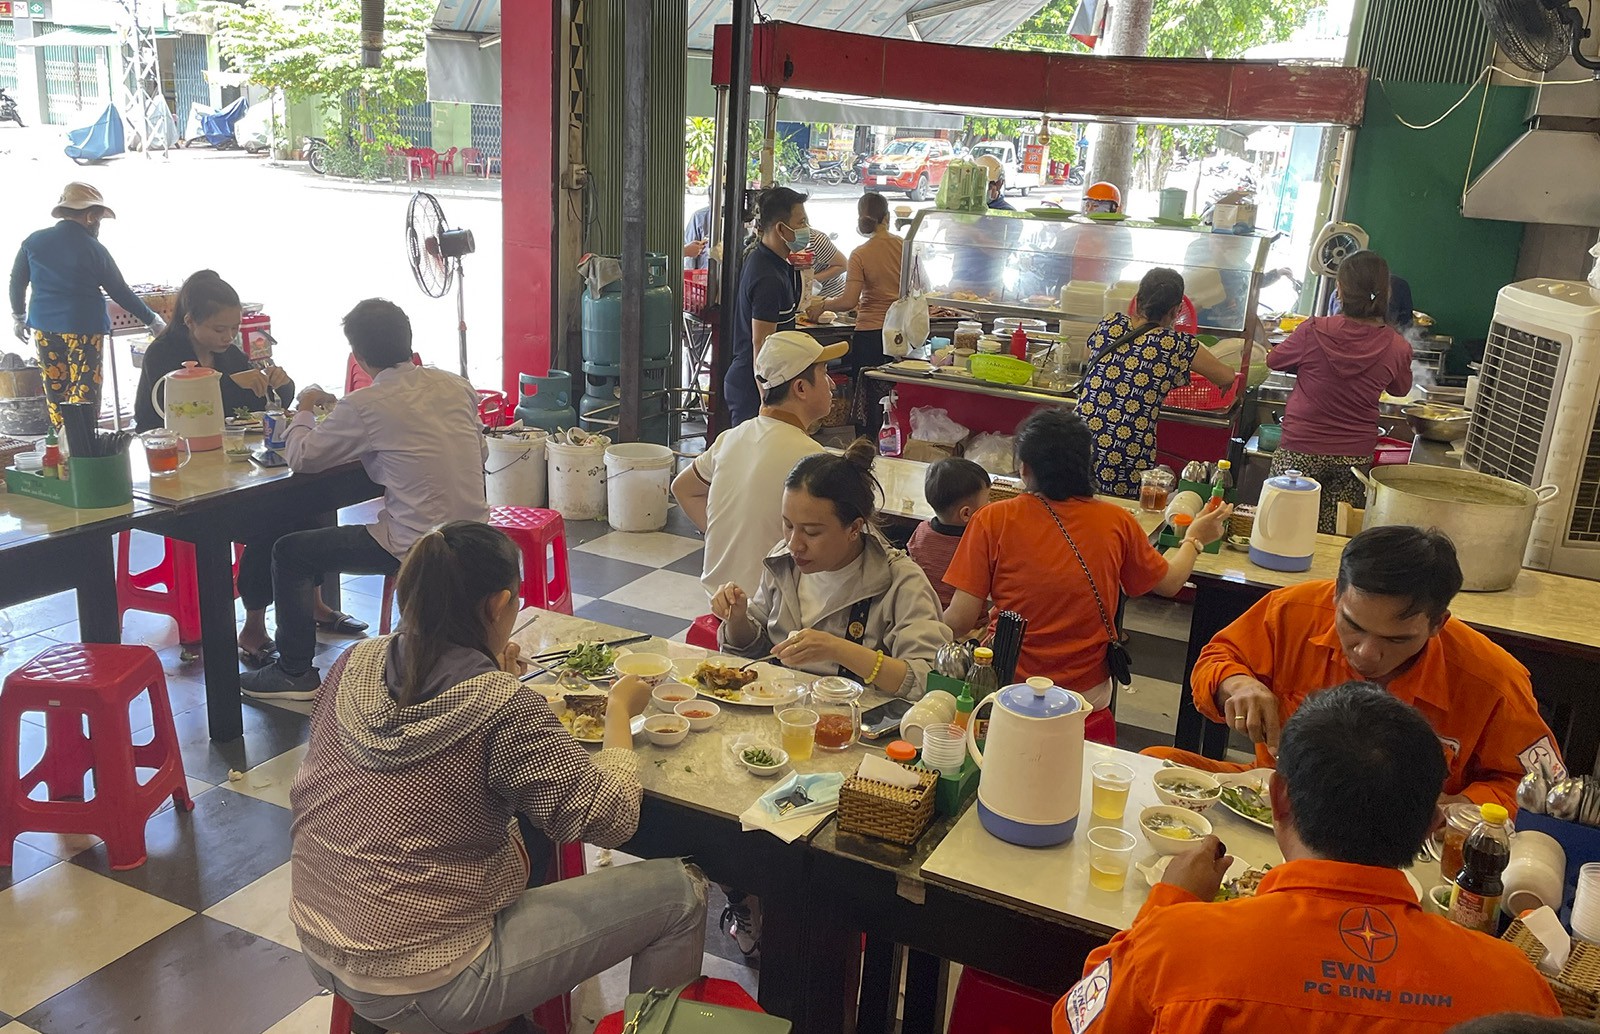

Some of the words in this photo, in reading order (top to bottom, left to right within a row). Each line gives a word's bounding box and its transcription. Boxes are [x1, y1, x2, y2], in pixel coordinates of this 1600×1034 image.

[1321, 960, 1376, 983] EVN
[1303, 981, 1332, 995] PC
[1339, 985, 1392, 1002] BINH
[1400, 991, 1453, 1007] DINH
